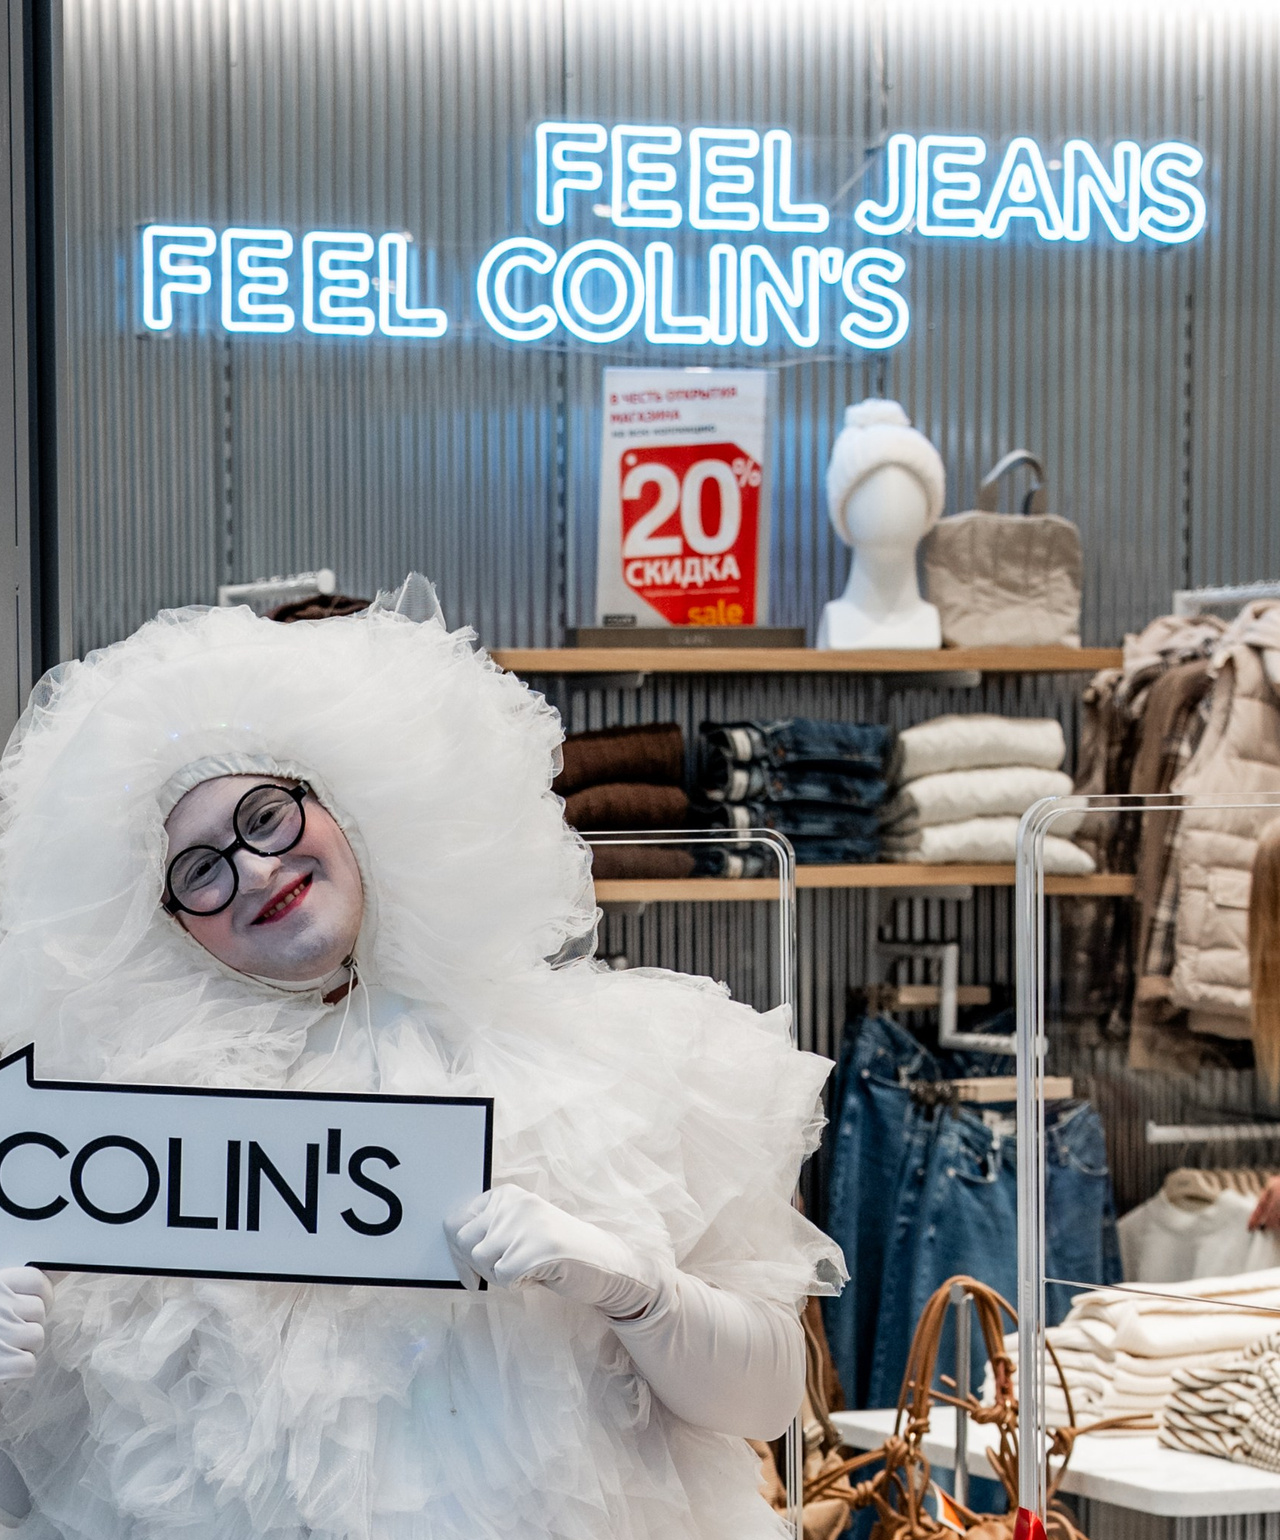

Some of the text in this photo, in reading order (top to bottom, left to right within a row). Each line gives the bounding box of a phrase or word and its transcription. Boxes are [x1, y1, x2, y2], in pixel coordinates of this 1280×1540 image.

[535, 121, 1207, 244] FEEL JEANS
[142, 224, 910, 349] FEEL COLIN'S
[625, 554, 742, 589] СКИДКА
[687, 599, 744, 627] sale
